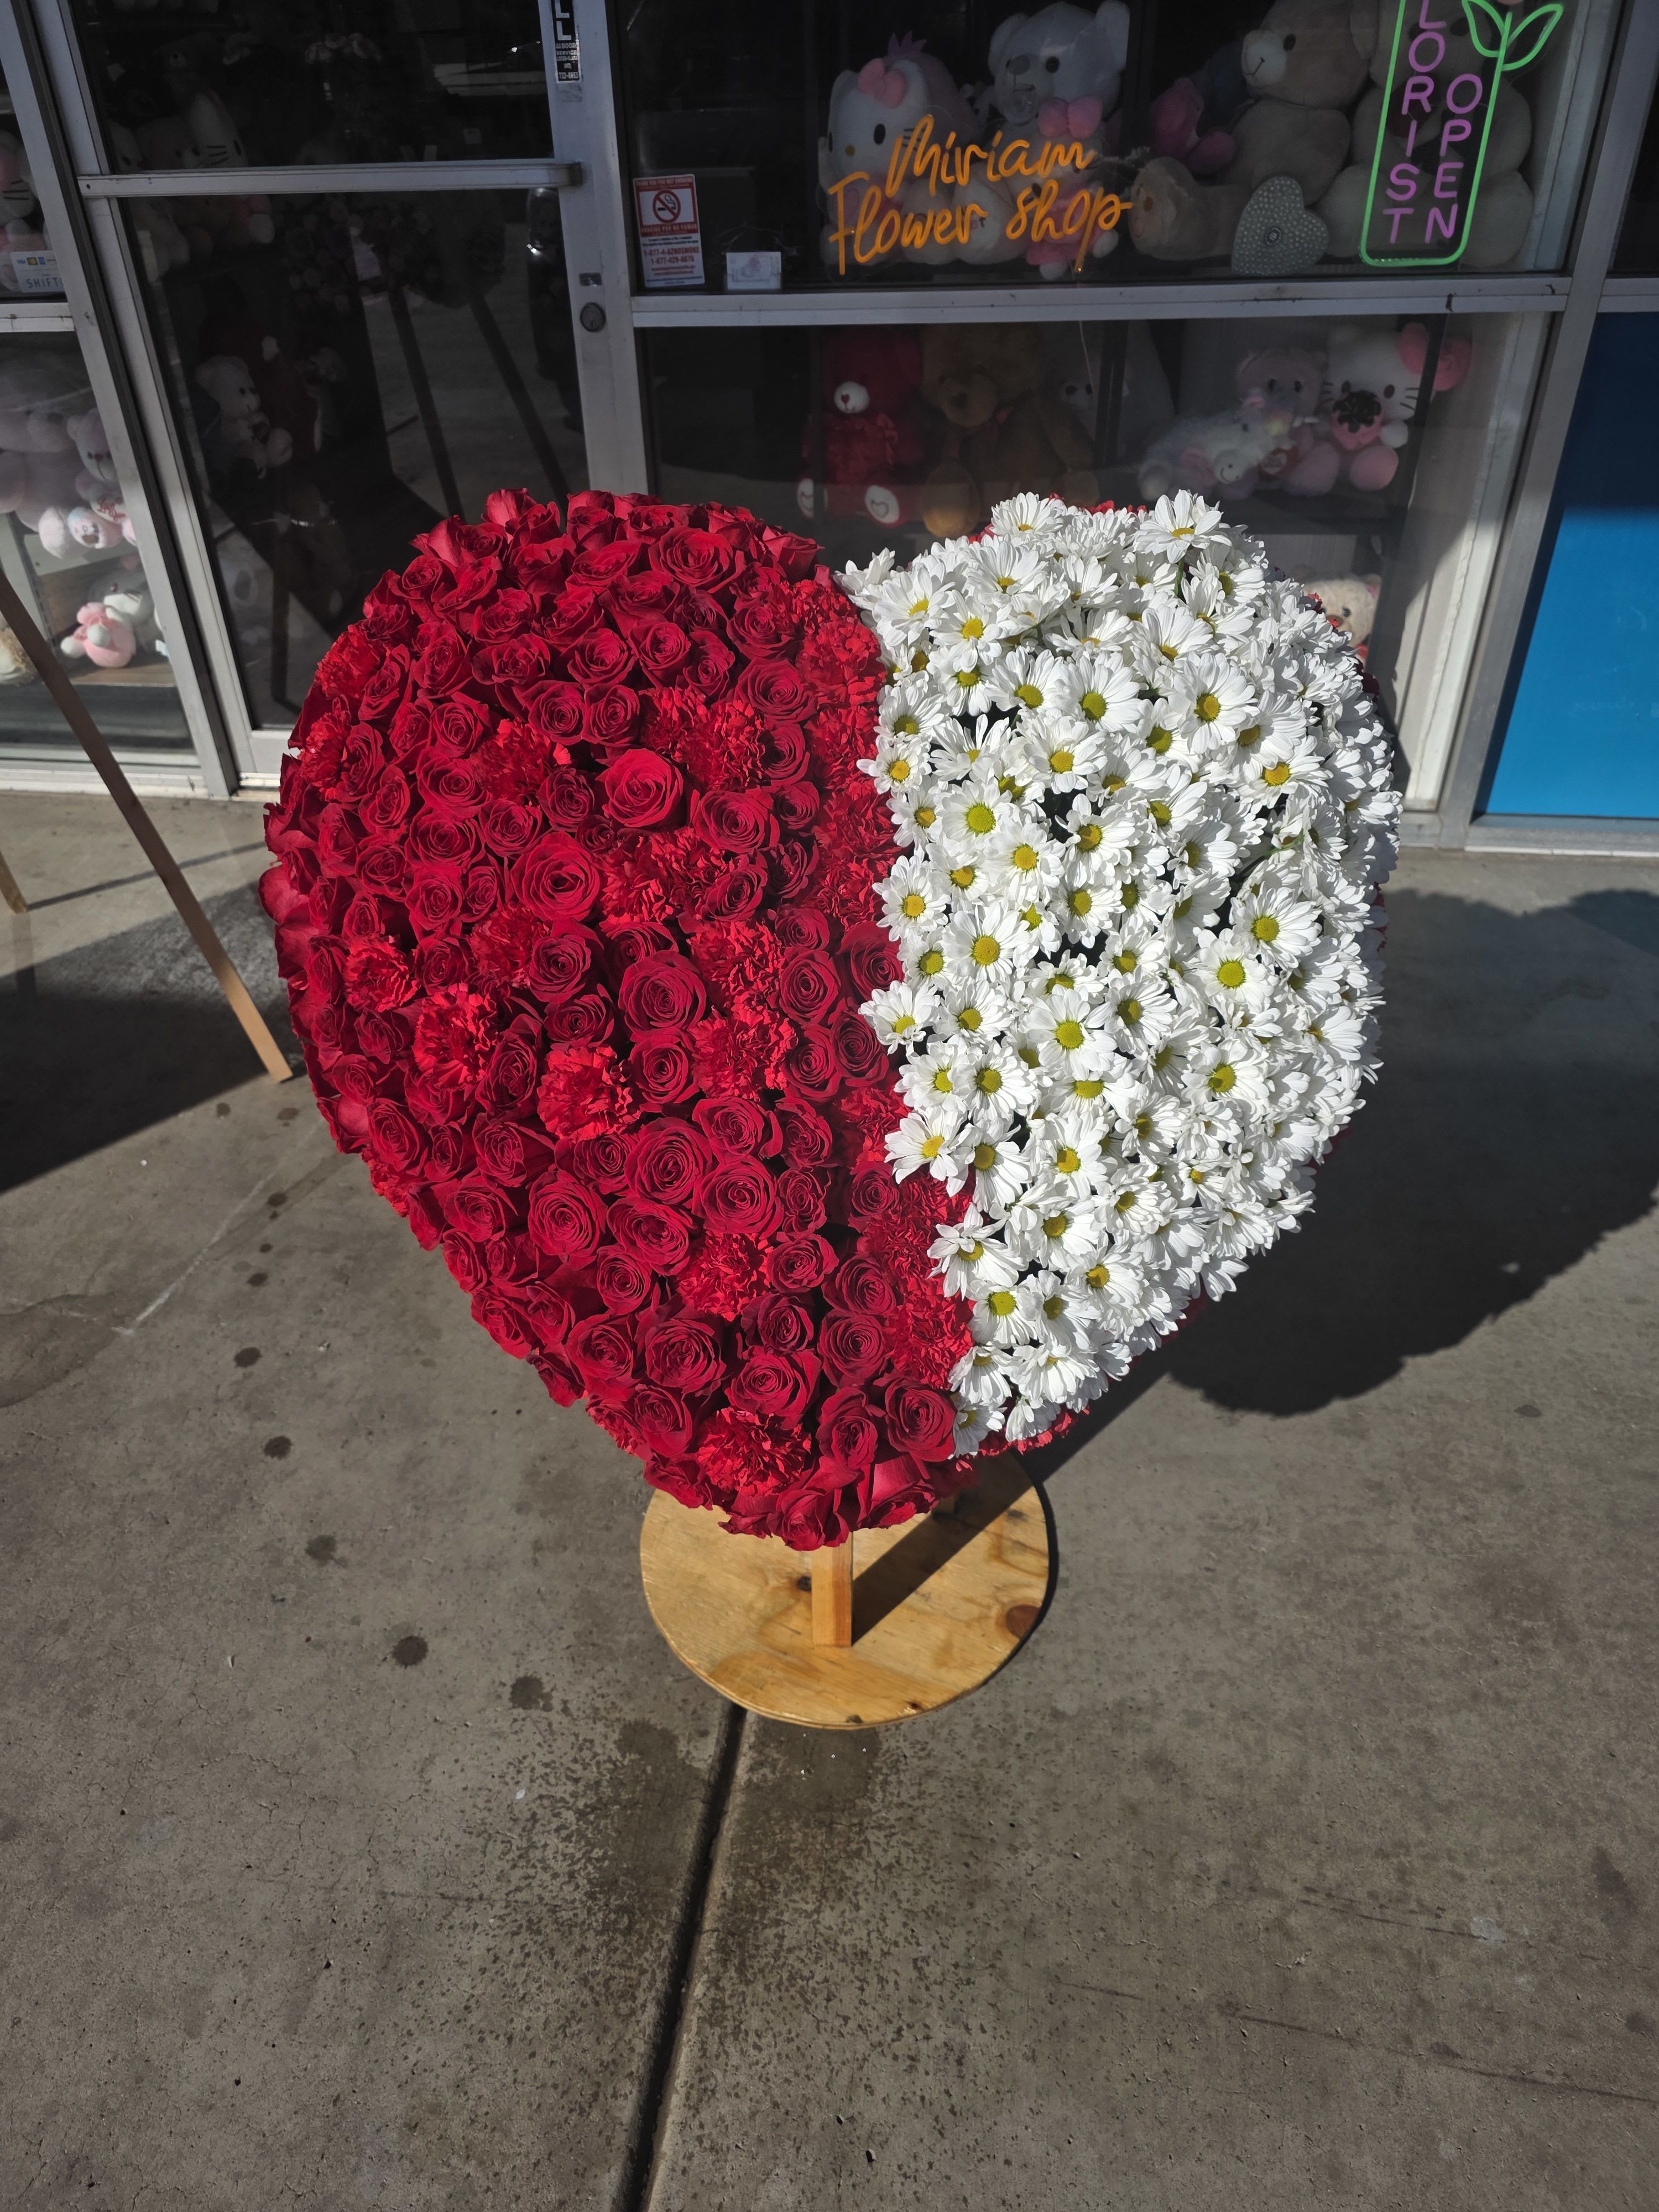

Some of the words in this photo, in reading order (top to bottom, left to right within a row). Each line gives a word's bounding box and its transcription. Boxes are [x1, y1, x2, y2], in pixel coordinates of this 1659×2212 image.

[885, 114, 1096, 198] Miriam
[1425, 73, 1483, 244] OPEN
[828, 171, 989, 276] Flower
